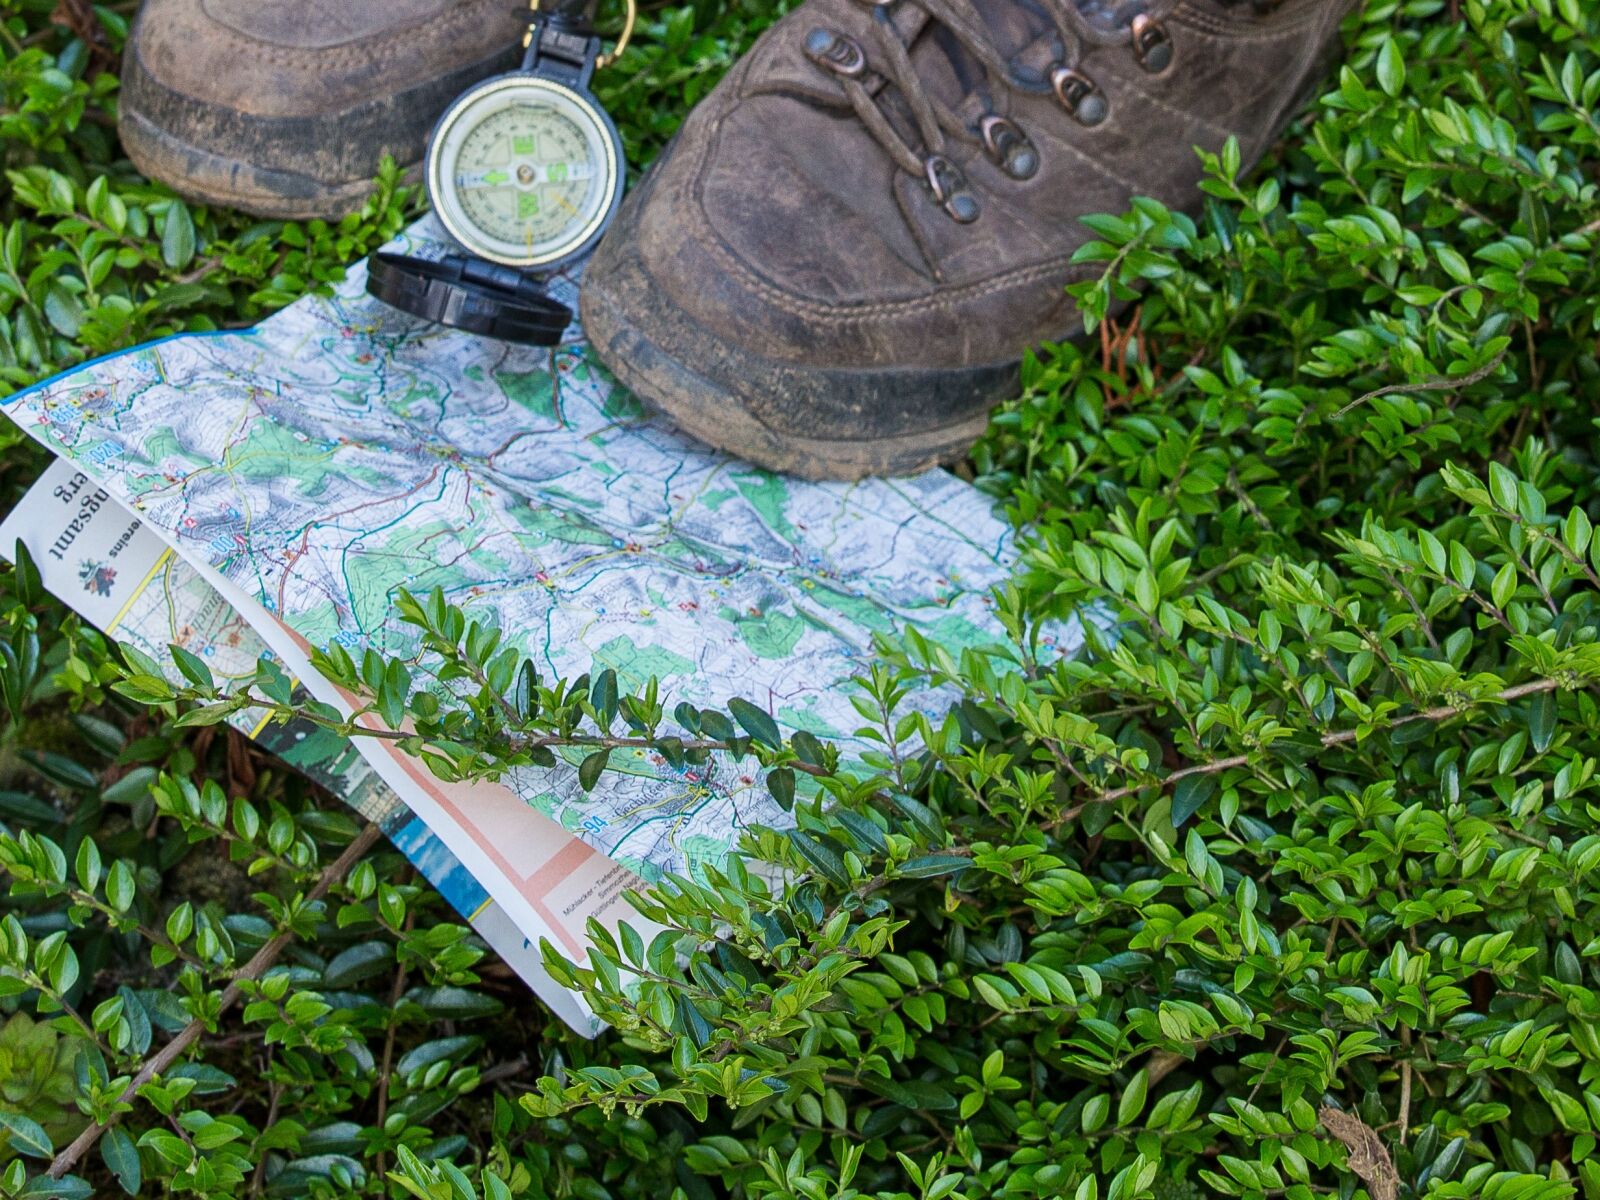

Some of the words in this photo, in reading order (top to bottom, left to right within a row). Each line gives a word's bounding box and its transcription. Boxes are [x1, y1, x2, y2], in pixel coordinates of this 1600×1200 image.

[53, 472, 88, 504] erg
[49, 488, 110, 561] ngsamt
[583, 815, 609, 834] 94
